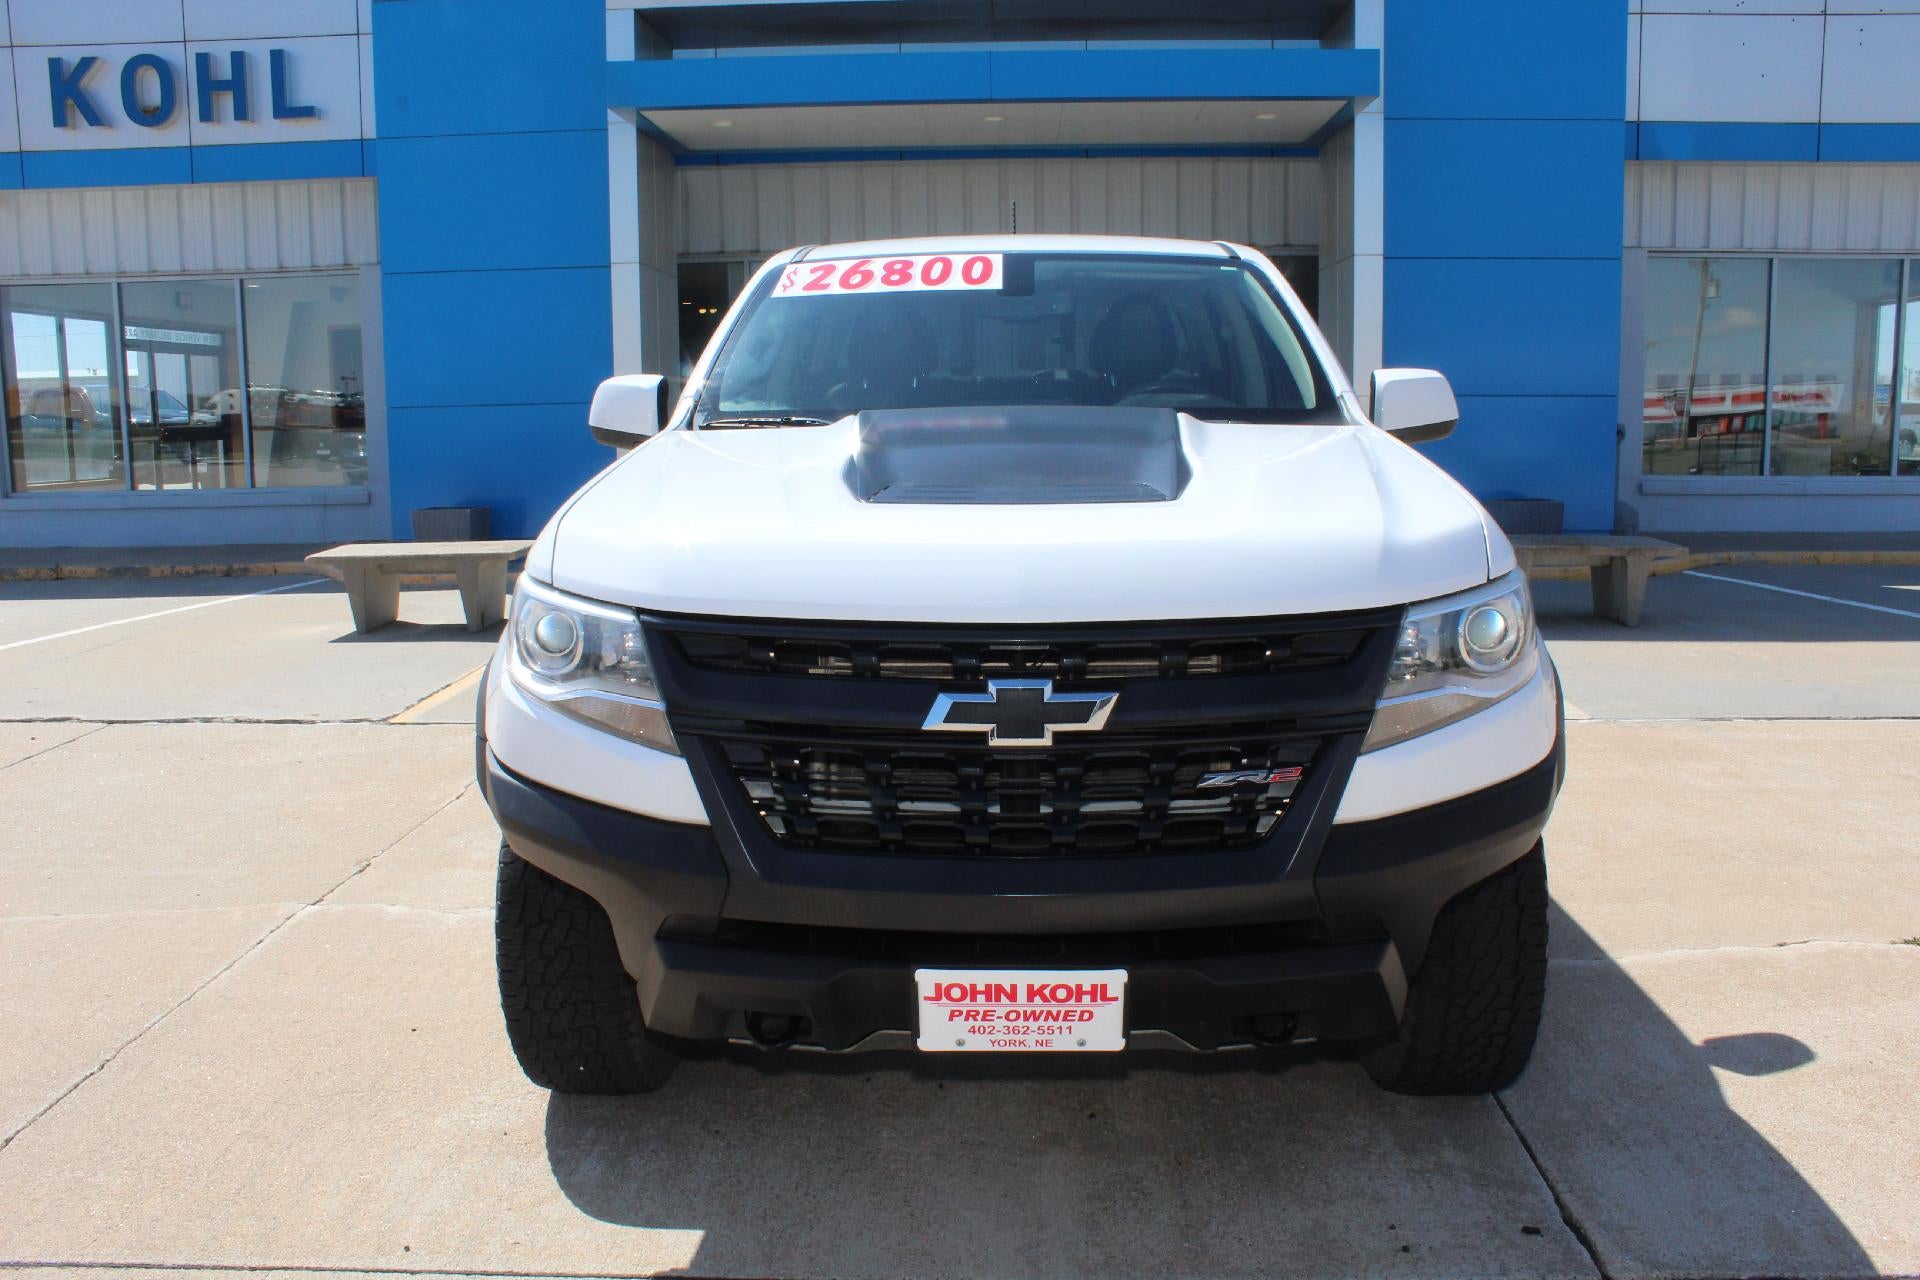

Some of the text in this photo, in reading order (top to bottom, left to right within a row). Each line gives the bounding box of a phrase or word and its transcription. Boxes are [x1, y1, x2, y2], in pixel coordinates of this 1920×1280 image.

[47, 48, 319, 128] KOHL
[782, 255, 994, 293] $26800
[1196, 766, 1303, 788] ZR2
[923, 982, 1119, 1003] JOHN KOHL
[948, 1009, 1094, 1022] PRE-OWNED
[967, 1025, 1073, 1035] 402-362-5511
[989, 1039, 1054, 1048] YORK, NE
